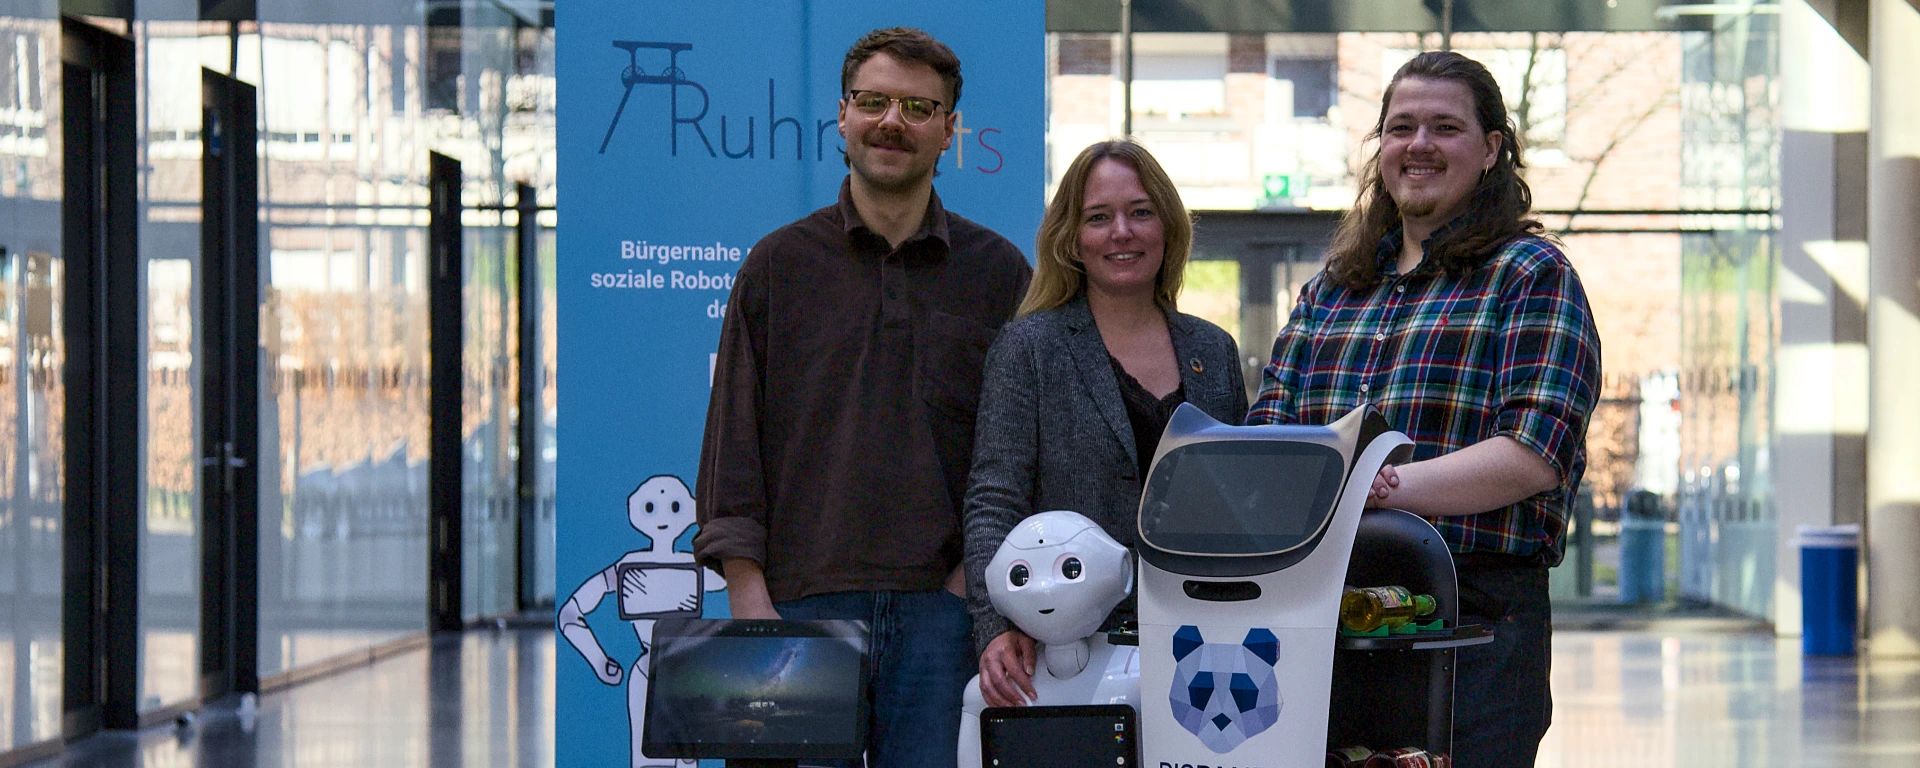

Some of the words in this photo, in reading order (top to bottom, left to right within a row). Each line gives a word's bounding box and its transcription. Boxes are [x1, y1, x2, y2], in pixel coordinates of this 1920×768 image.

[620, 240, 741, 265] Bürgernahe
[590, 269, 665, 289] soziale
[670, 270, 737, 290] Robot
